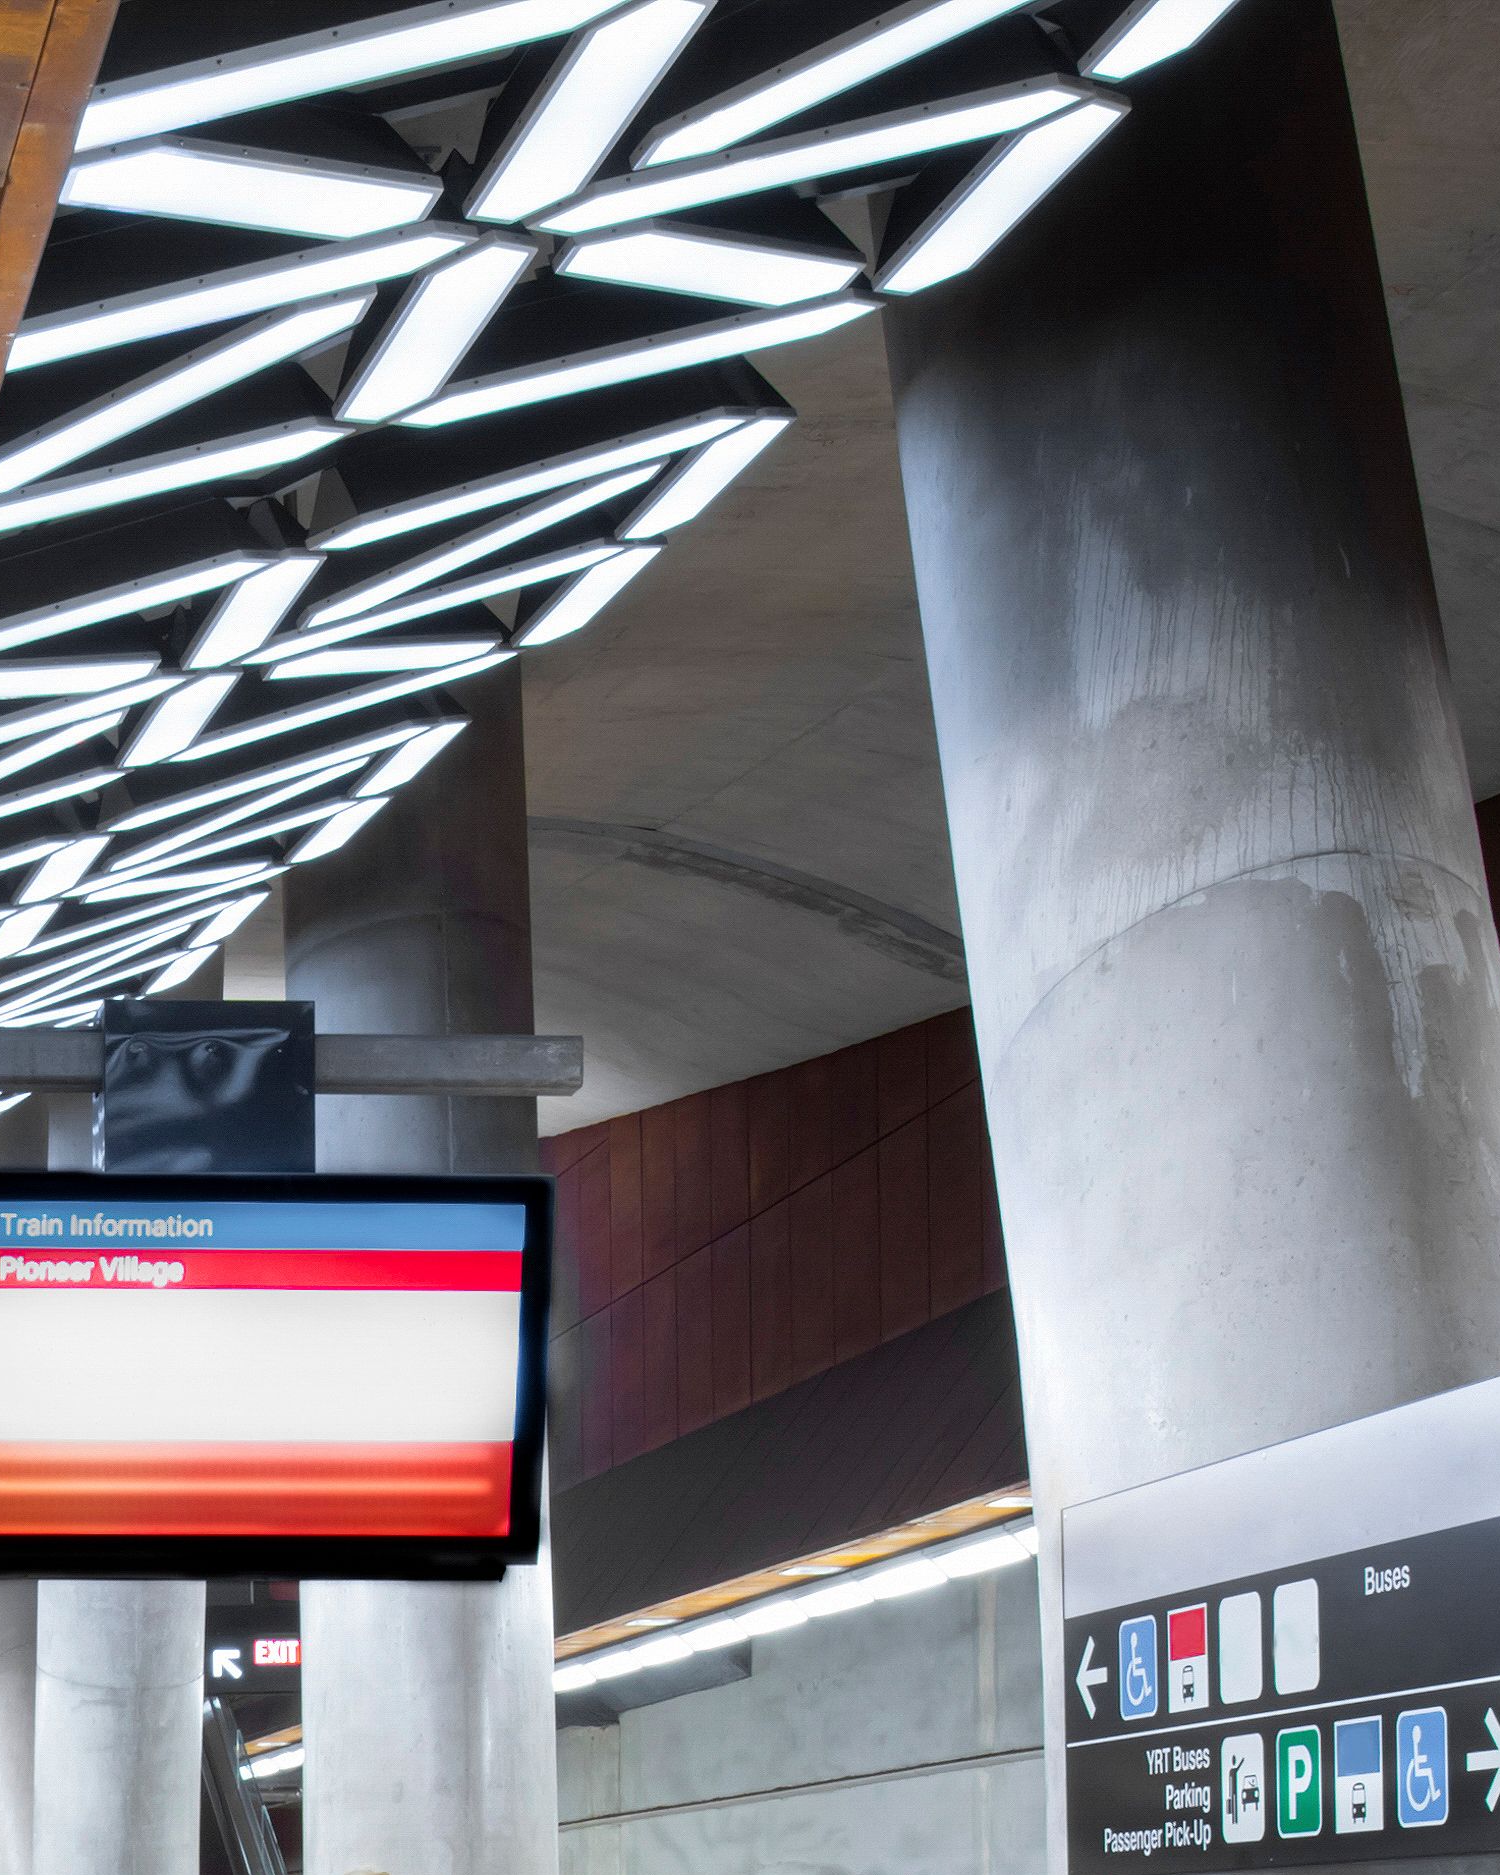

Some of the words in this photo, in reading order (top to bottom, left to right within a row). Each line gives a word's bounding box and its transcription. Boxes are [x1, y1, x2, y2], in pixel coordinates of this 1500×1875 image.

[0, 1212, 63, 1237] Train
[70, 1213, 213, 1238] Information
[0, 1256, 95, 1282] Pioneer
[99, 1256, 185, 1287] Village
[1364, 1565, 1410, 1596] Buses
[255, 1640, 299, 1664] EXIT
[1146, 1747, 1171, 1775] YRT
[1173, 1746, 1210, 1772] Buses
[1165, 1782, 1211, 1813] Parking
[1288, 1745, 1312, 1820] P
[1104, 1828, 1163, 1856] Passenger
[1165, 1819, 1211, 1851] Pick-Up
